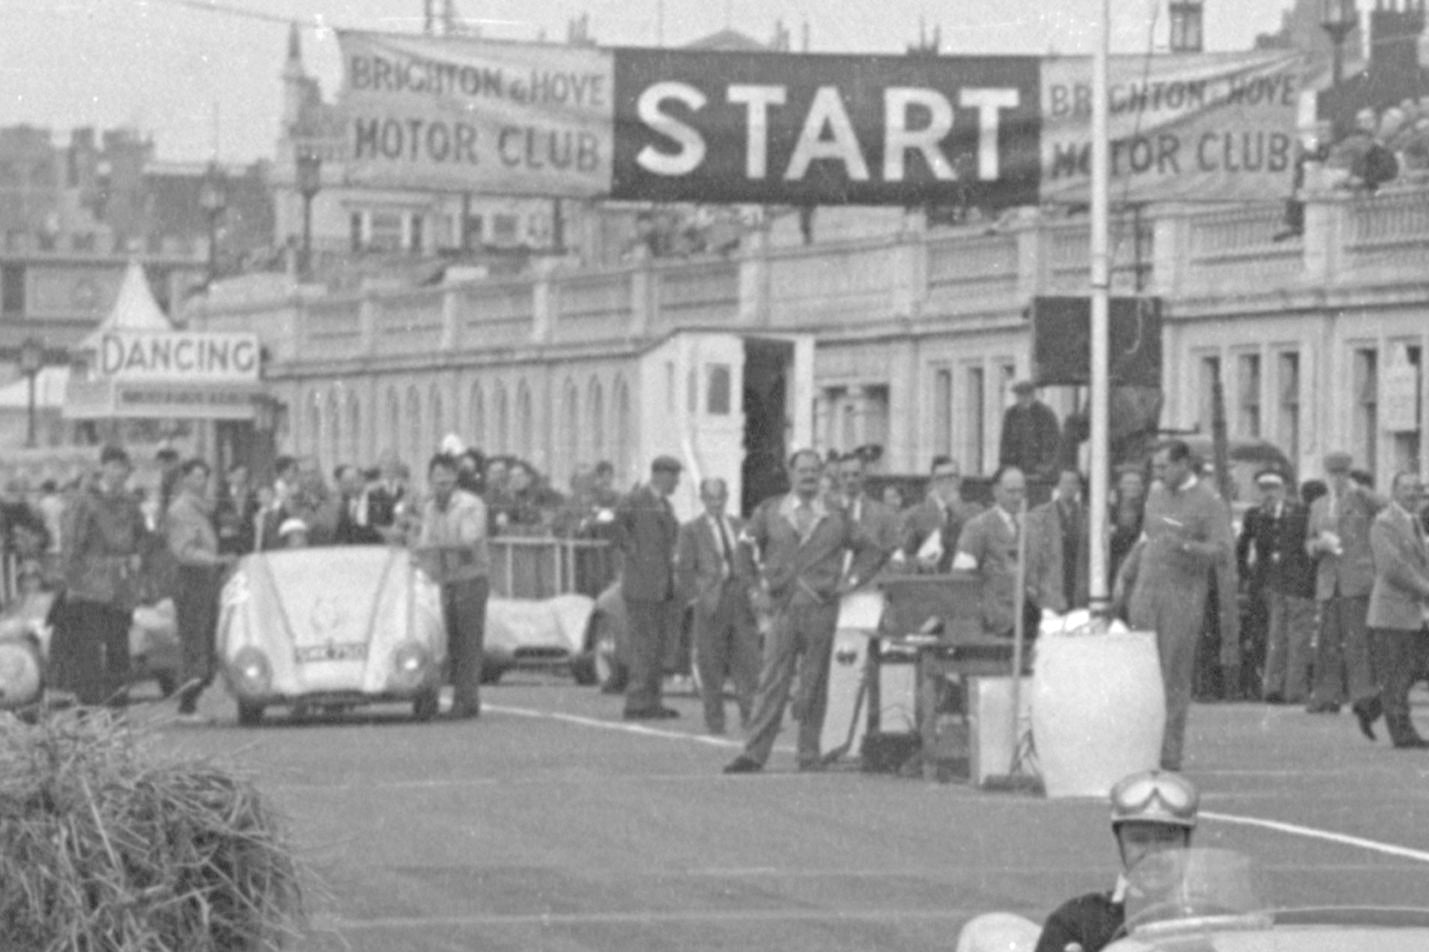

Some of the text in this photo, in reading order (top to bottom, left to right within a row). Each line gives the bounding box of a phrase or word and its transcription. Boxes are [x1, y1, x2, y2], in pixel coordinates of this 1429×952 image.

[351, 55, 503, 98] BRIGHTON
[530, 70, 605, 106] HOVE
[1050, 80, 1206, 117] BRGHTON
[354, 117, 600, 172] MOTOR CLUB
[636, 81, 1020, 182] START
[1197, 131, 1292, 173] CLUB
[102, 335, 254, 375] DANCING
